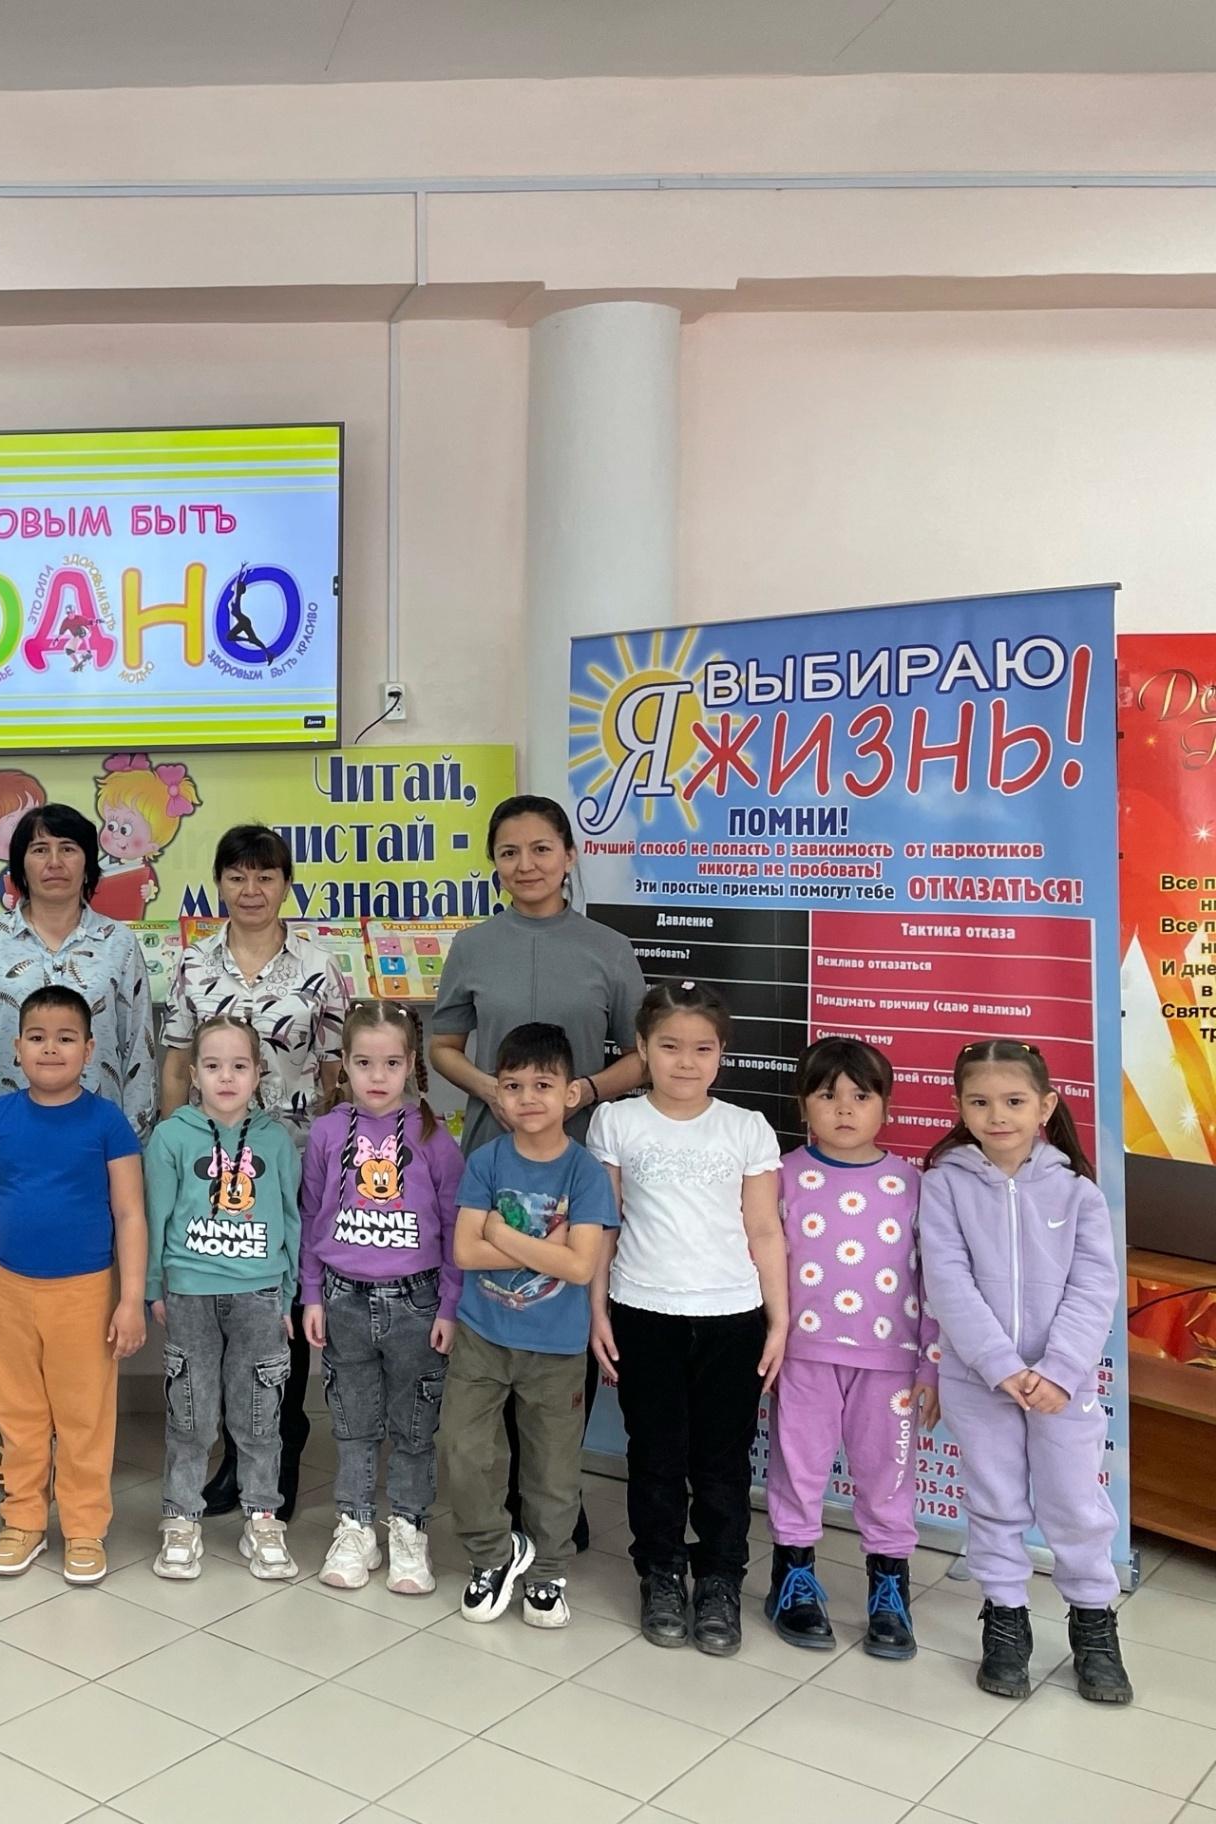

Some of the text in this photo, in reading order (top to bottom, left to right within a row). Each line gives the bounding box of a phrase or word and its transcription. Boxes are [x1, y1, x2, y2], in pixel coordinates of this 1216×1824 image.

[131, 504, 237, 535] БЫТЬ
[63, 553, 108, 602] ЗДОРОВЫМ
[28, 564, 55, 625] ЭТО СИЛА
[207, 602, 319, 681] ЗДОРОВЫМ БЫТЬ КРАСИВО
[118, 660, 155, 684] МОДНО
[682, 643, 1093, 802] ЖИЗНЬ!
[577, 637, 1069, 836] Я ВЫБИРАЮ
[314, 754, 477, 808] Читай,
[729, 807, 848, 836] ПОМНИ!
[584, 840, 1044, 859] Лучший способ не попасть в зависимость от наркотиков
[698, 862, 883, 878] никогда не пробовать!
[635, 876, 1084, 905] Эти простые приемы помогут тебе ОТКАЗАТЬСЯ!
[1161, 875, 1198, 890] Все
[657, 913, 714, 928] Давление
[901, 922, 1016, 940] Тактика отказа
[1161, 918, 1198, 933] Все
[817, 955, 933, 971] Вежливо отказаться
[1161, 961, 1175, 976] И
[1201, 985, 1213, 997] в
[816, 994, 1033, 1018] Придумать причину (сдаю анализы)
[865, 1034, 894, 1046] тему
[1065, 1084, 1090, 1098] был
[897, 1114, 956, 1129] интереса.
[186, 1216, 267, 1240] MINNIE
[336, 1207, 418, 1230] MINNIE
[185, 1235, 267, 1259] MOUSE
[334, 1226, 419, 1249] MOUSE
